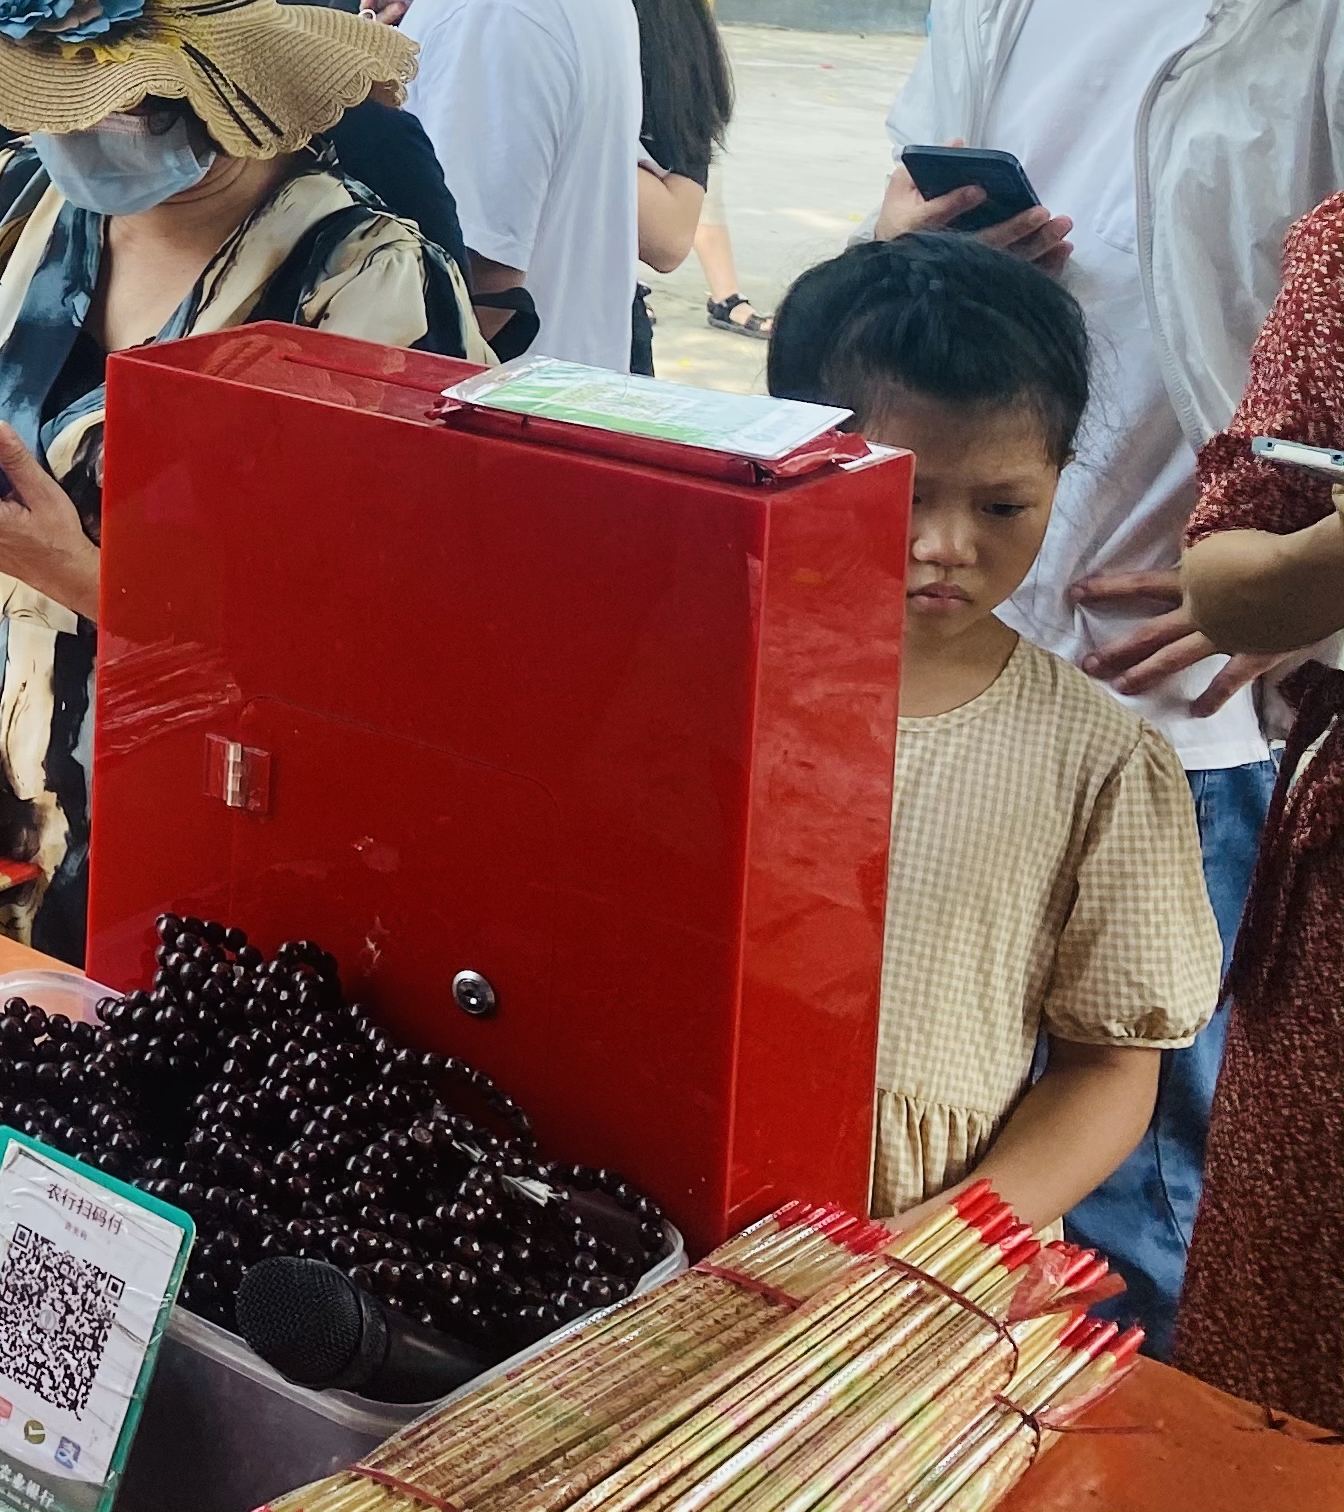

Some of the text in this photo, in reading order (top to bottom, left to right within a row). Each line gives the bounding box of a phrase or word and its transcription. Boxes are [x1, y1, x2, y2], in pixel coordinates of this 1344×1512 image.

[46, 1182, 124, 1235] 农行扫码付
